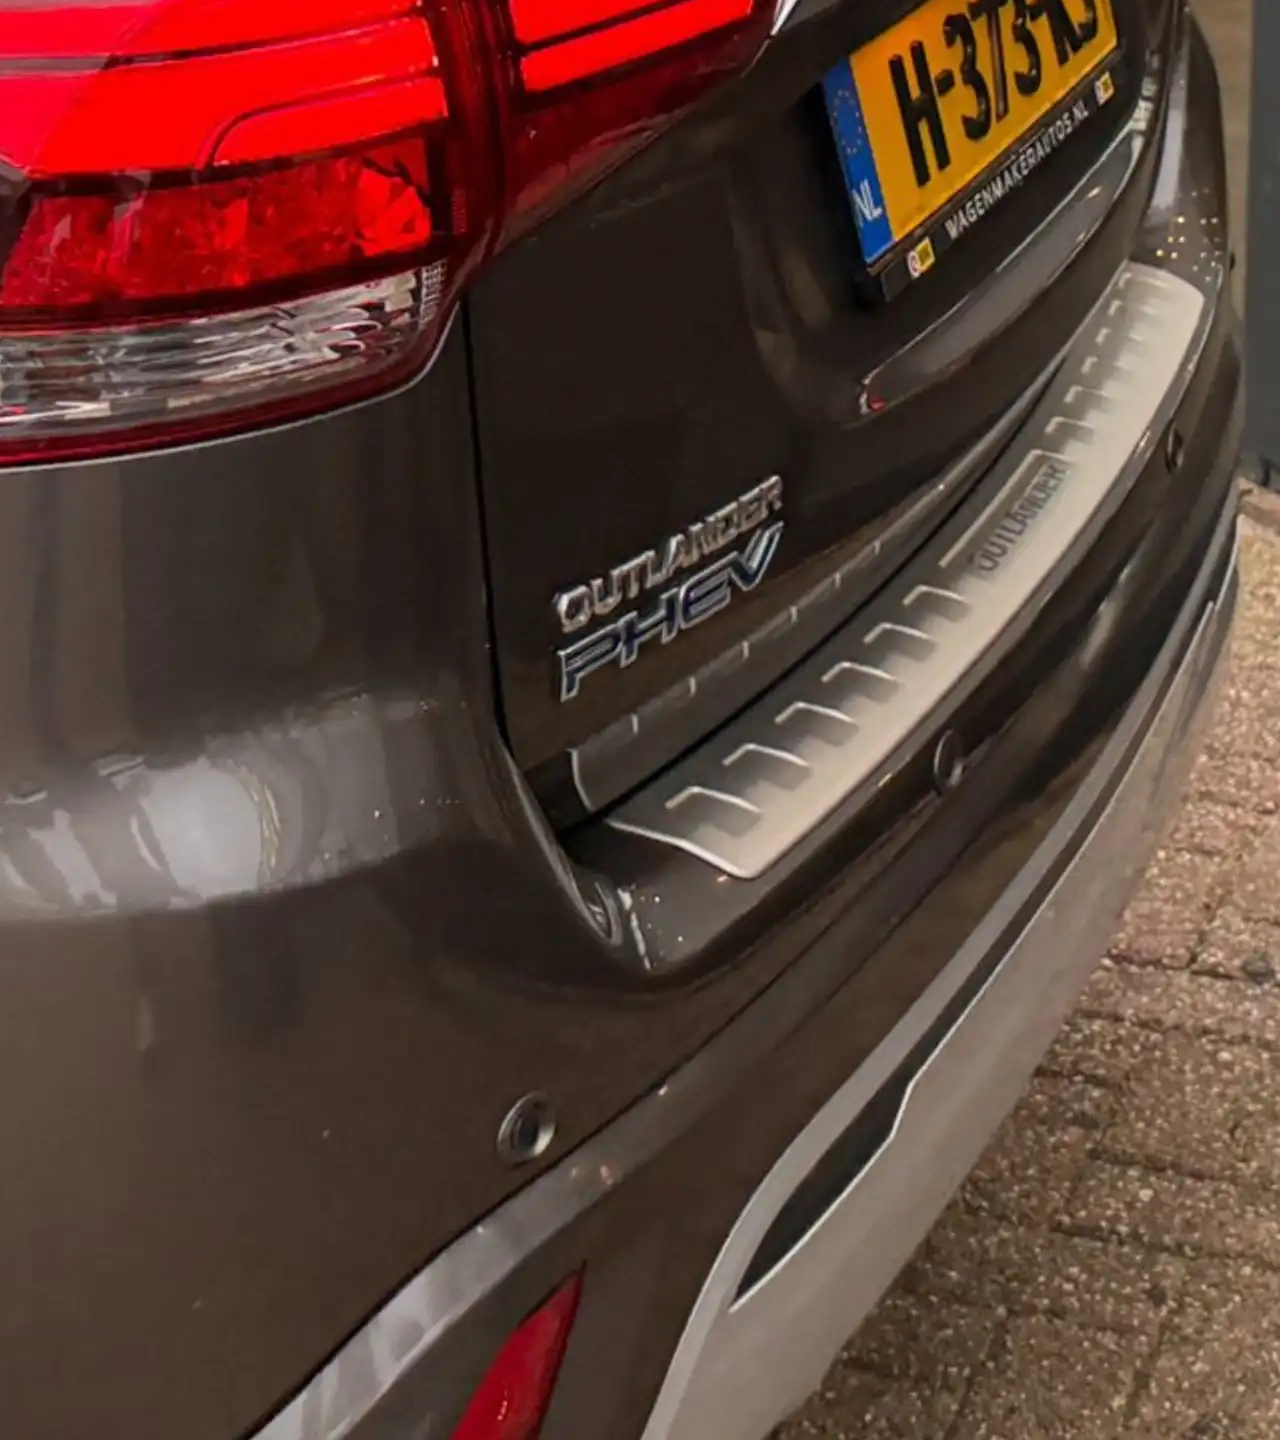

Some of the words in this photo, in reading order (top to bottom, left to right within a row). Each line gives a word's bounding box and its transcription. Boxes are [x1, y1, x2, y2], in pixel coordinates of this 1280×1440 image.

[852, 178, 882, 228] NL
[554, 474, 783, 633] OUTLANDER
[556, 521, 785, 703] PHEV
